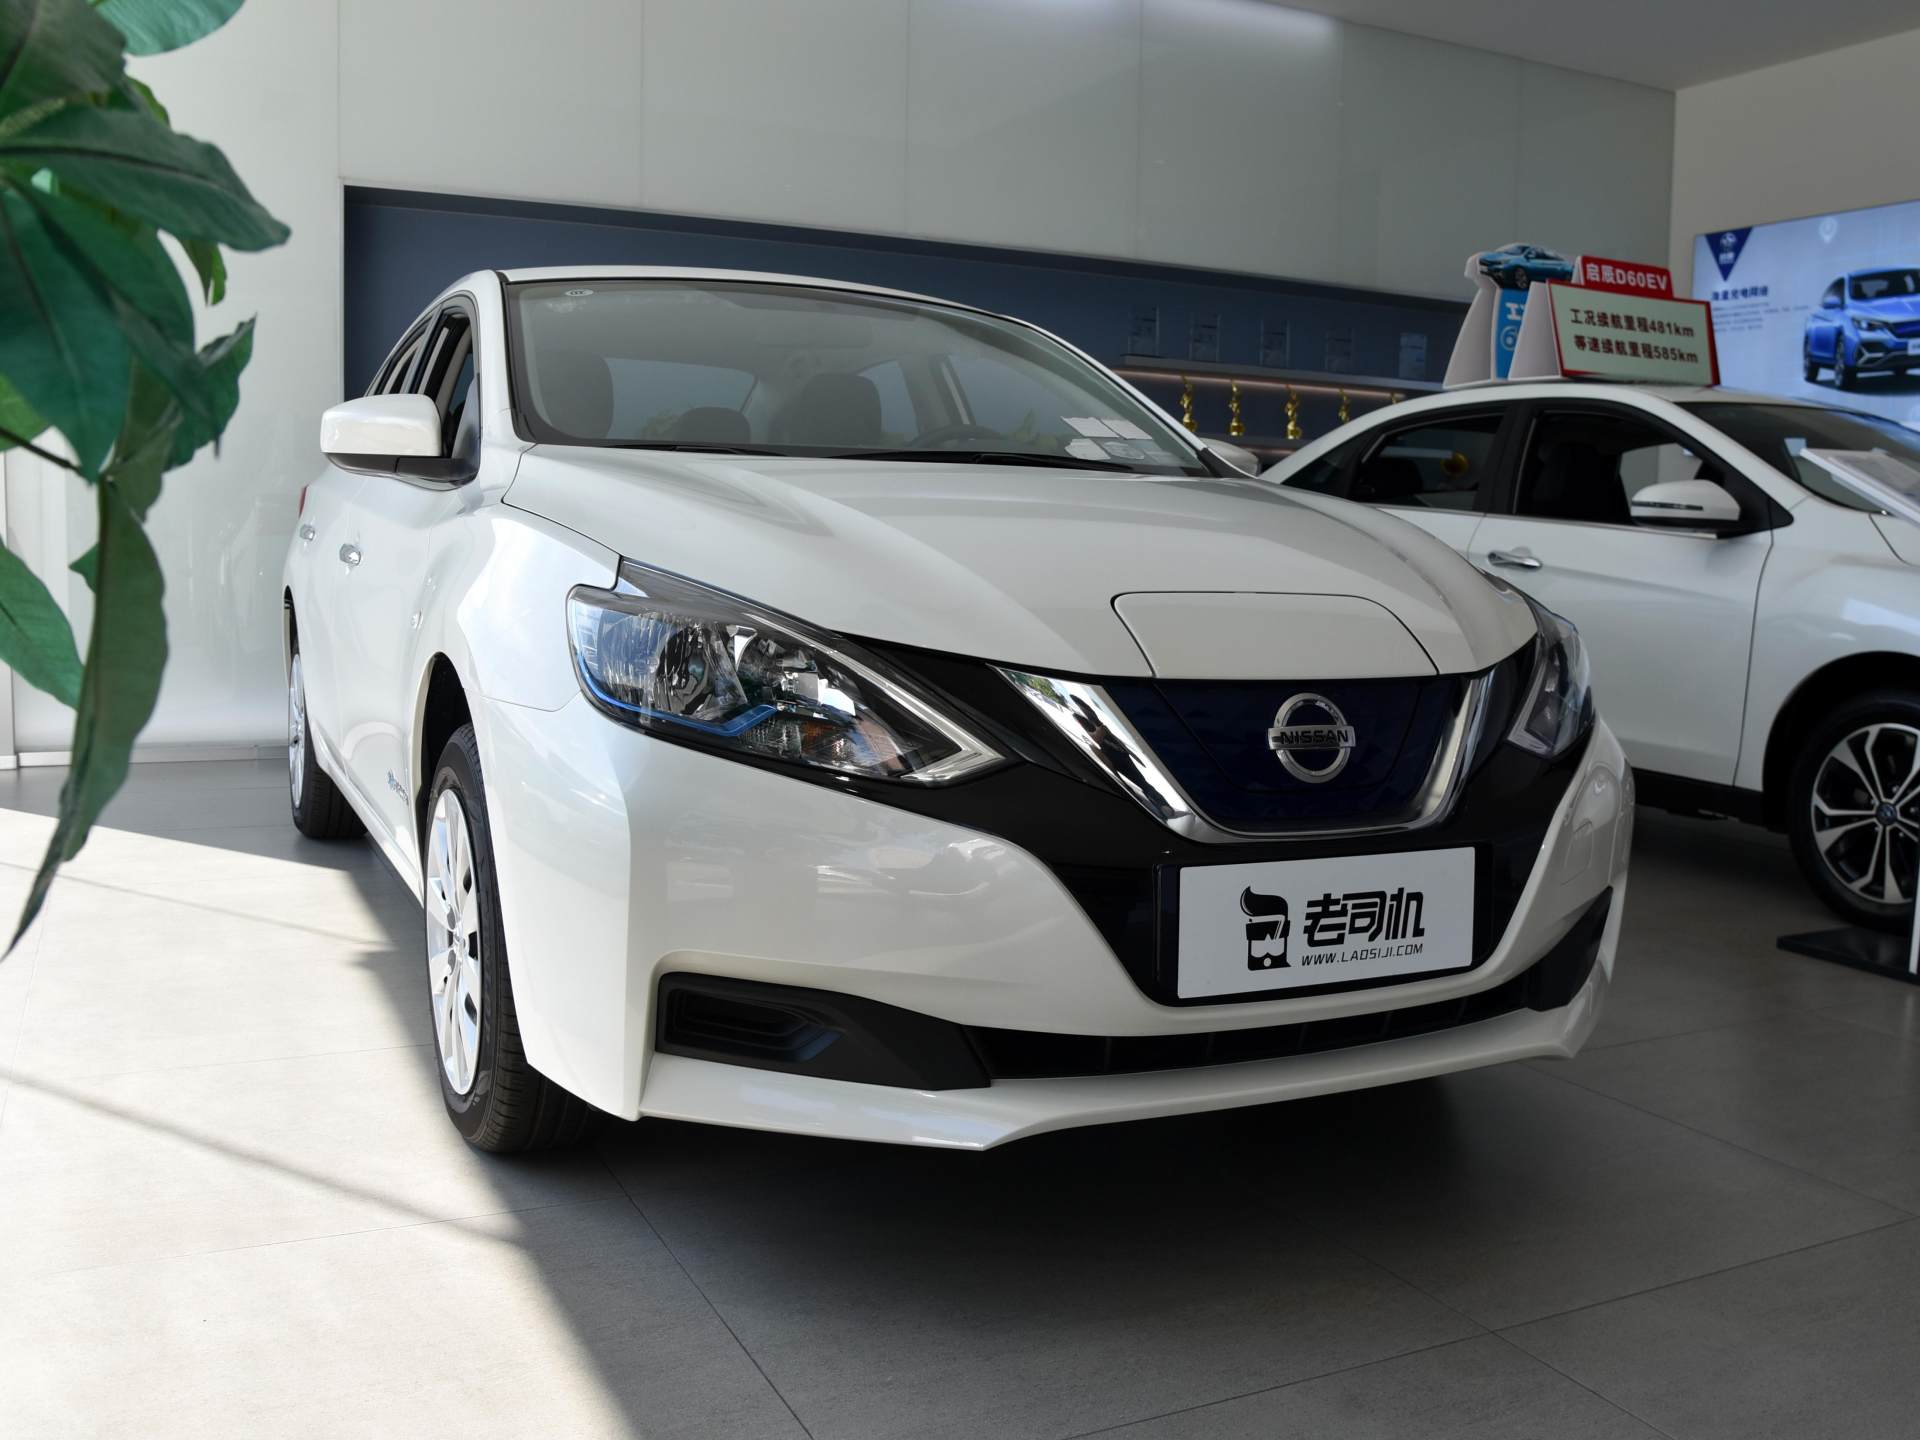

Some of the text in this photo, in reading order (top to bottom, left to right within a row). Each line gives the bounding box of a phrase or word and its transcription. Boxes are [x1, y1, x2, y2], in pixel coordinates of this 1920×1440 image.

[1586, 263, 1667, 290] 启辰D60EV
[1570, 308, 1694, 337] 工况续航里程481km
[1574, 335, 1698, 363] 等速续航里程585km
[1280, 730, 1348, 745] NISSAN
[1303, 887, 1425, 947] 老司机
[1301, 943, 1423, 967] WWW.LAOSIJI.COM
